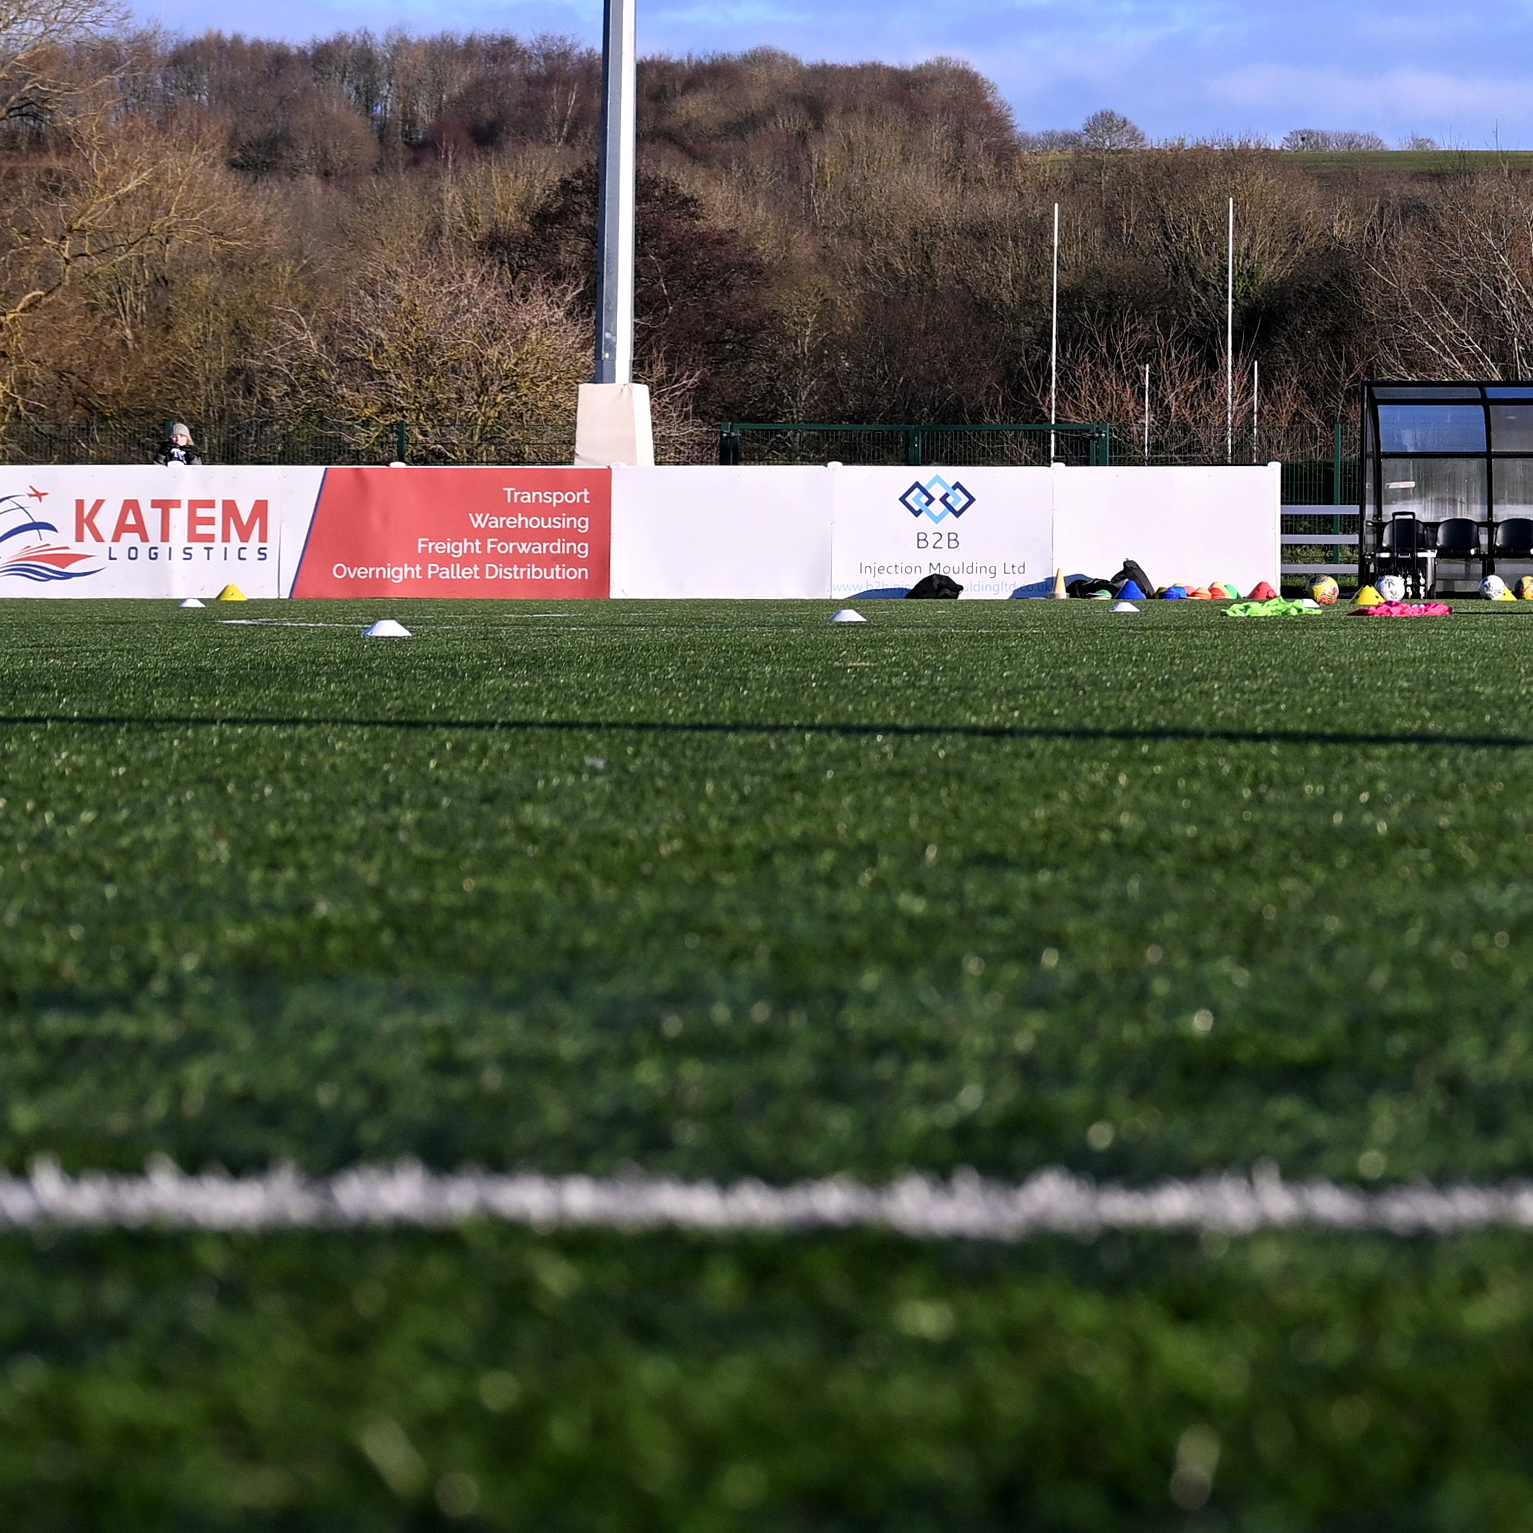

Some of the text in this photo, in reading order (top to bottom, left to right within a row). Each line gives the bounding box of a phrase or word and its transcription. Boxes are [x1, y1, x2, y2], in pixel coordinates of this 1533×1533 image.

[503, 488, 590, 507] Transport
[74, 499, 268, 543] KATEM
[469, 513, 590, 533] Warehousing
[418, 538, 590, 558] Freight Forwarding
[917, 532, 960, 549] B2B
[108, 546, 267, 561] LOGISTICS
[333, 563, 590, 583] Overnight Pallet Distribution
[860, 562, 1026, 578] Injection Moulding Ltd
